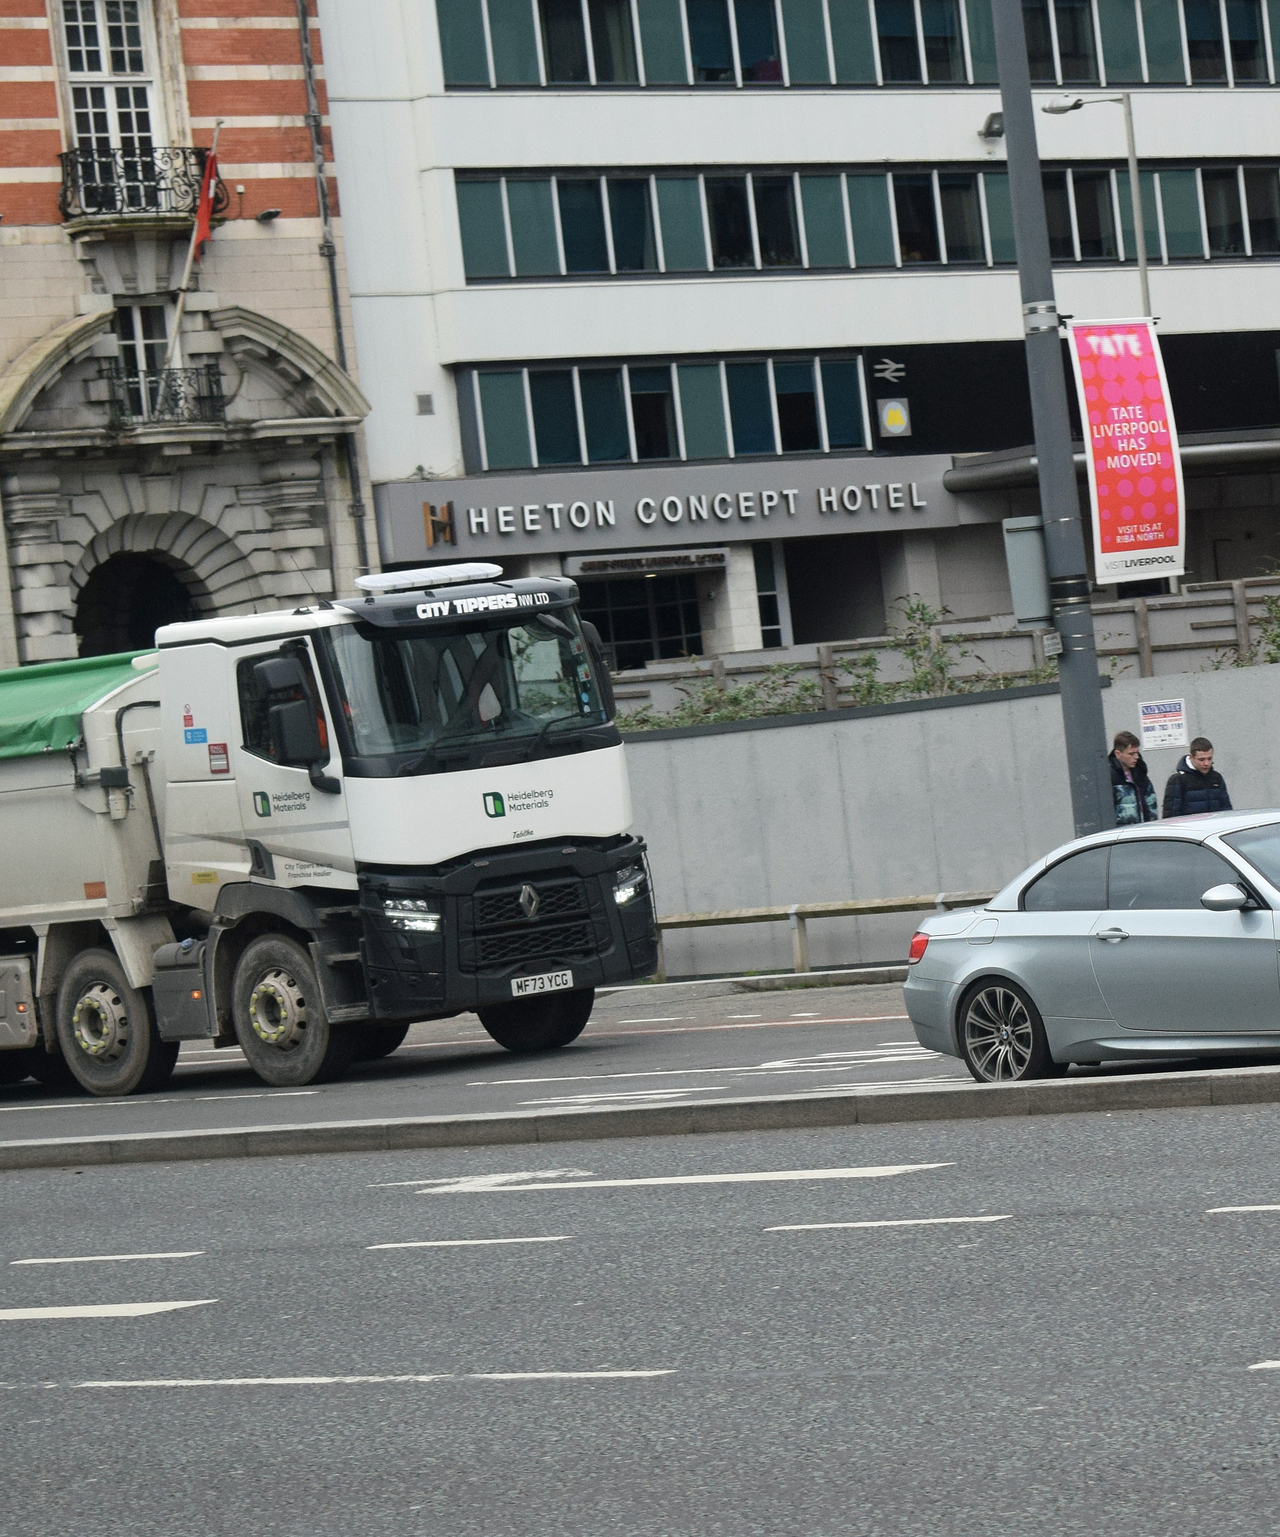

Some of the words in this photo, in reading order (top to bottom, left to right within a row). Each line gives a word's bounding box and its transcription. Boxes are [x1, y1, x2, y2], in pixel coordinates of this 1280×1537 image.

[1111, 405, 1143, 420] TATE
[1092, 420, 1167, 438] LIVERPOOL
[1117, 437, 1147, 452] HAS
[1106, 452, 1162, 469] MOVED!
[468, 500, 616, 534] HEETON
[636, 489, 799, 525] CONCEPT
[818, 482, 927, 512] HOTEL
[1117, 524, 1138, 534] VISIT
[1139, 523, 1151, 532] US
[1151, 522, 1162, 531] AT
[1116, 534, 1136, 544] RIBA
[1136, 532, 1165, 542] NORTH
[416, 600, 450, 619] CITY
[453, 593, 518, 614] TIPPERS
[517, 594, 533, 607] NW
[533, 592, 550, 605] LTD
[272, 791, 311, 802] Heidelberg
[507, 789, 554, 802] Heidelberg
[273, 802, 307, 813] Materials
[508, 800, 549, 812] Materials
[516, 977, 546, 994] MF73
[547, 973, 569, 988] YCG
